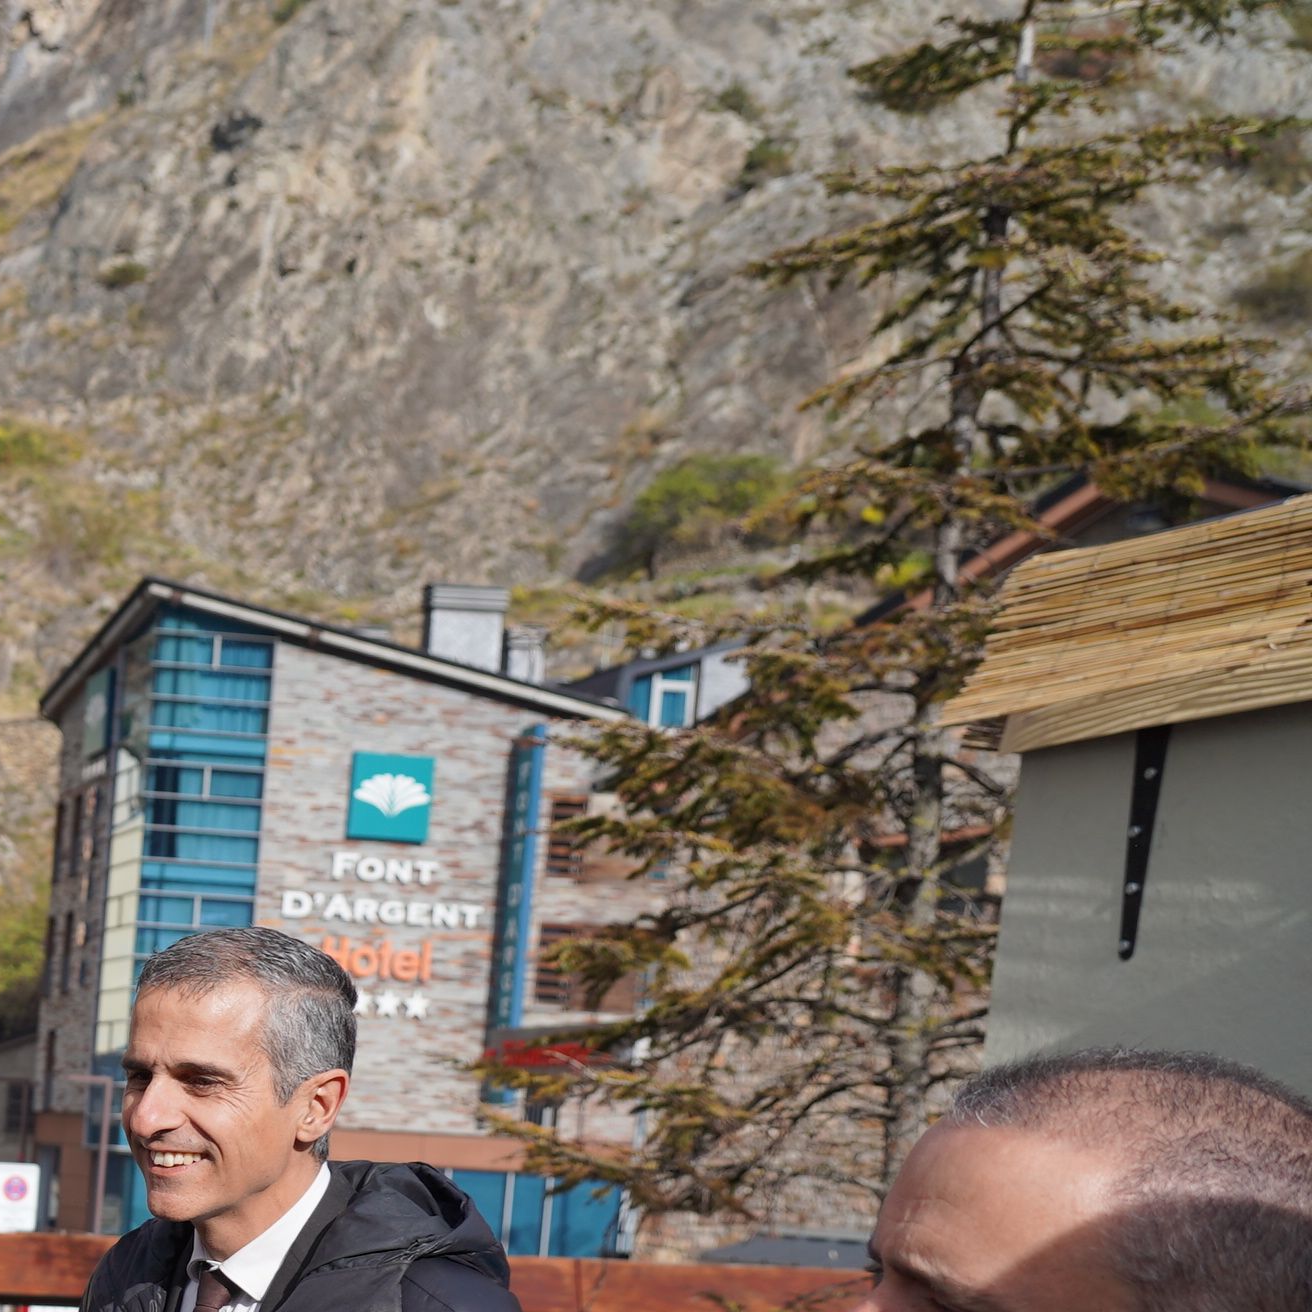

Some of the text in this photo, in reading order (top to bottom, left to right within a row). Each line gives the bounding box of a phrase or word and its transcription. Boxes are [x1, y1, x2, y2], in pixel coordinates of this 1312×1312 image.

[331, 851, 441, 885] FONT
[280, 889, 485, 928] D'ARGENT
[322, 935, 433, 982] Hotel
